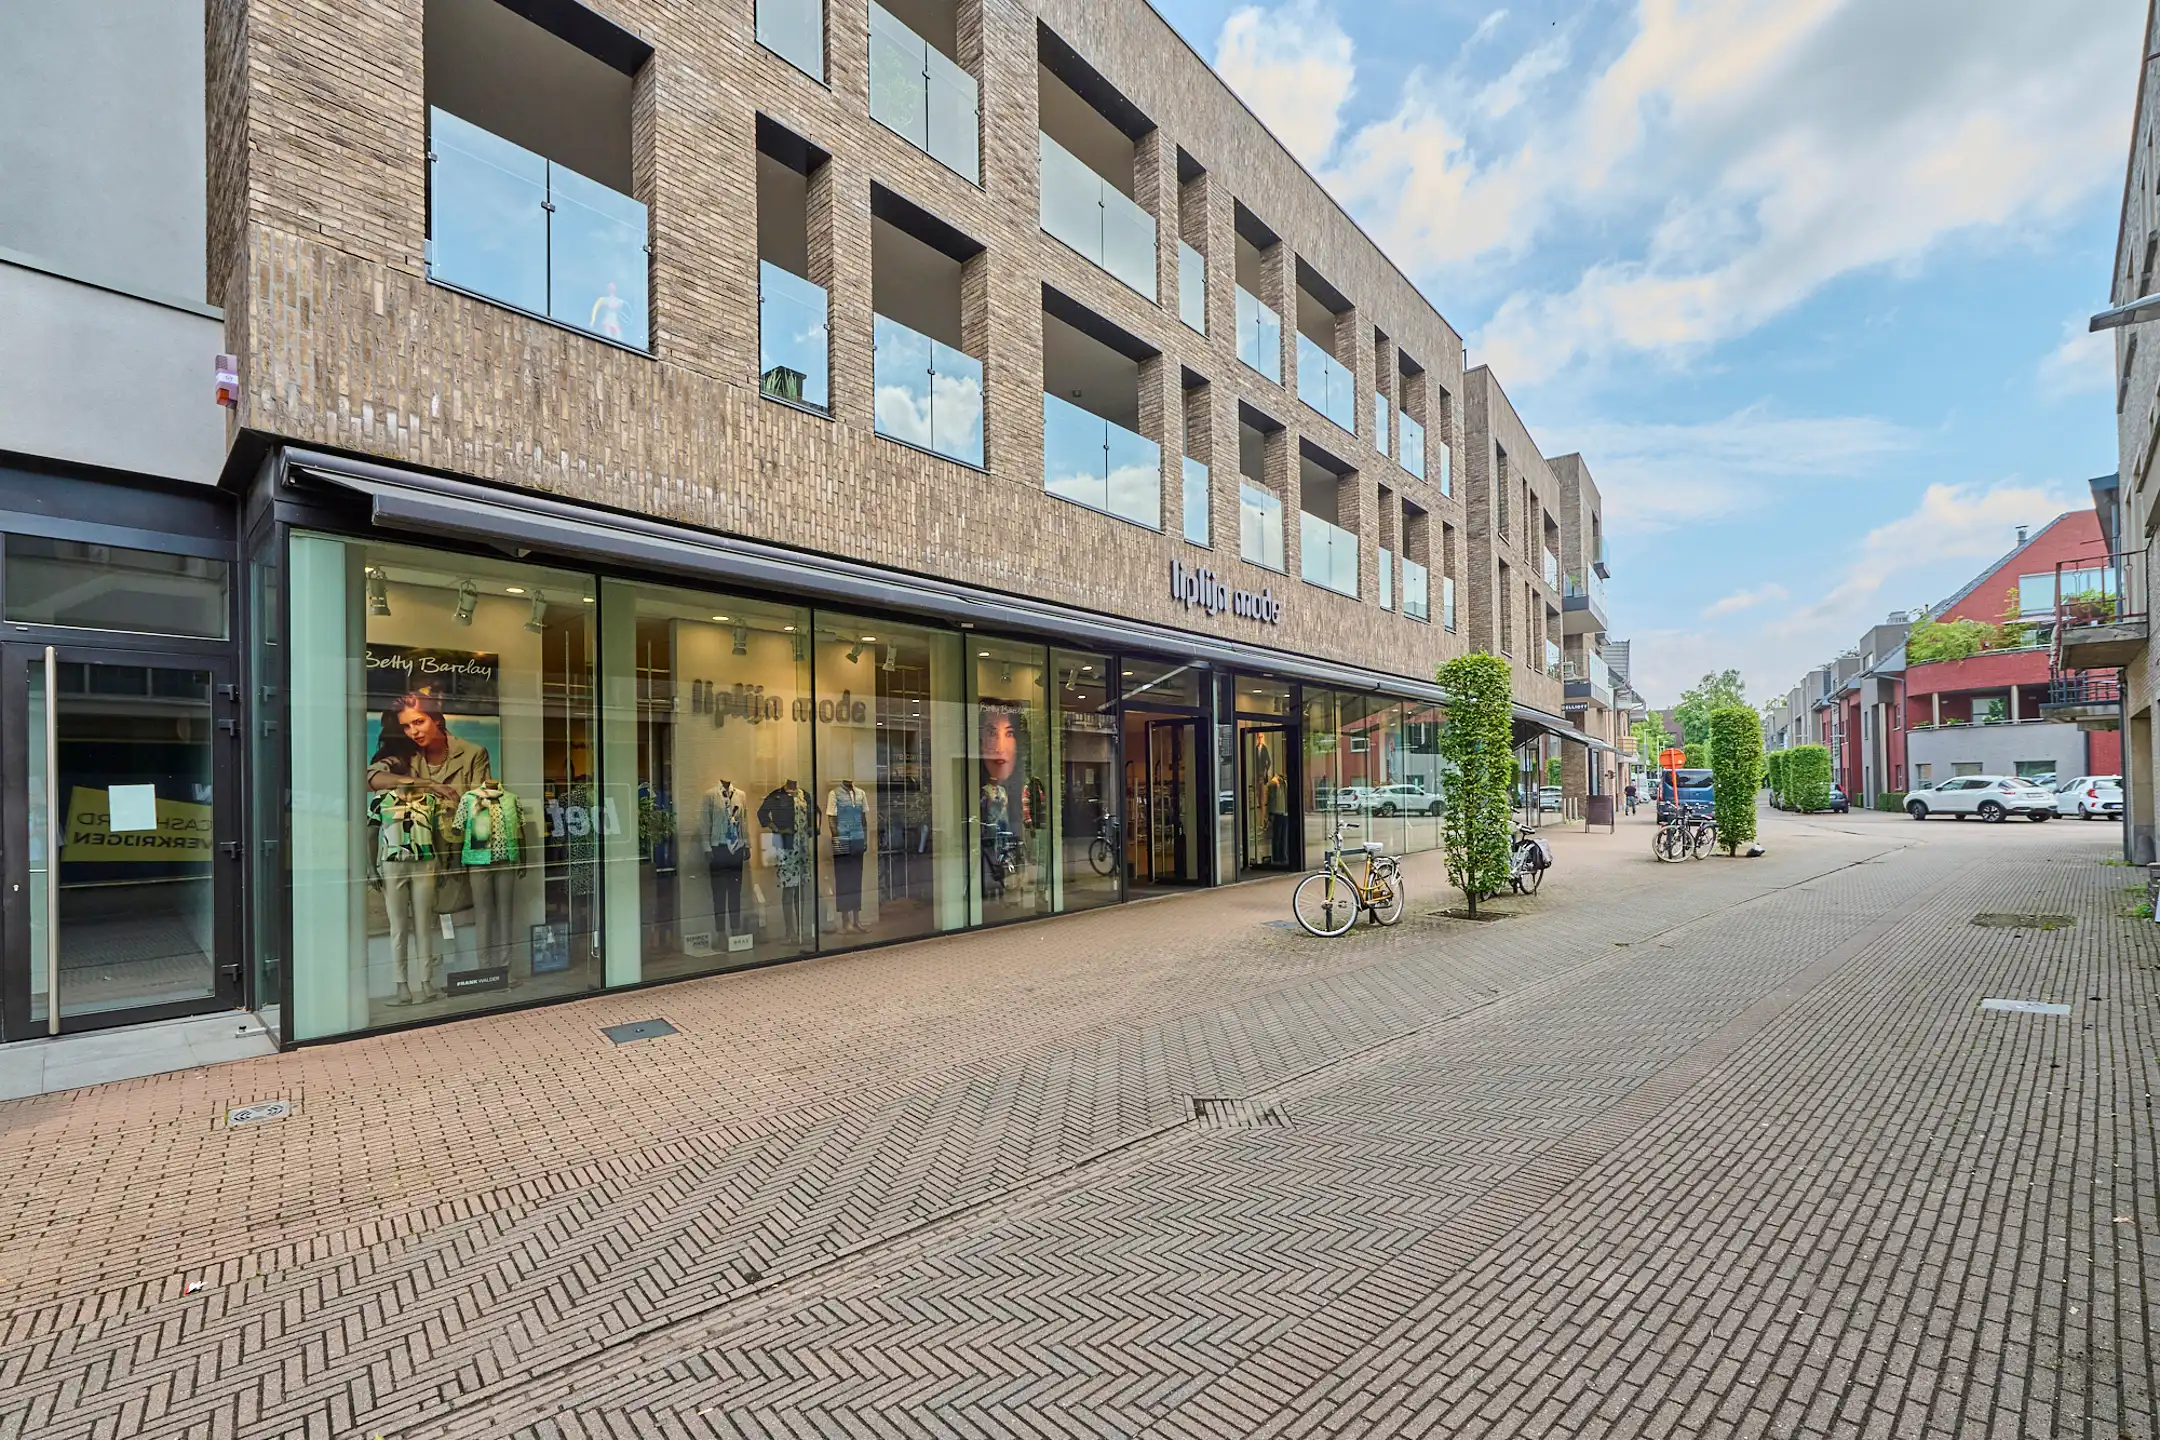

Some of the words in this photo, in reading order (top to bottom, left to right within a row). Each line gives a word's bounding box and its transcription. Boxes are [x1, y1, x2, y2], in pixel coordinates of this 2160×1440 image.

[1170, 559, 1228, 615] liplijn
[1233, 588, 1281, 624] mode
[366, 650, 413, 677] Betty
[419, 657, 492, 682] Barclay
[692, 678, 784, 728] liplijn
[791, 689, 867, 724] mode
[456, 979, 478, 987] FRANK
